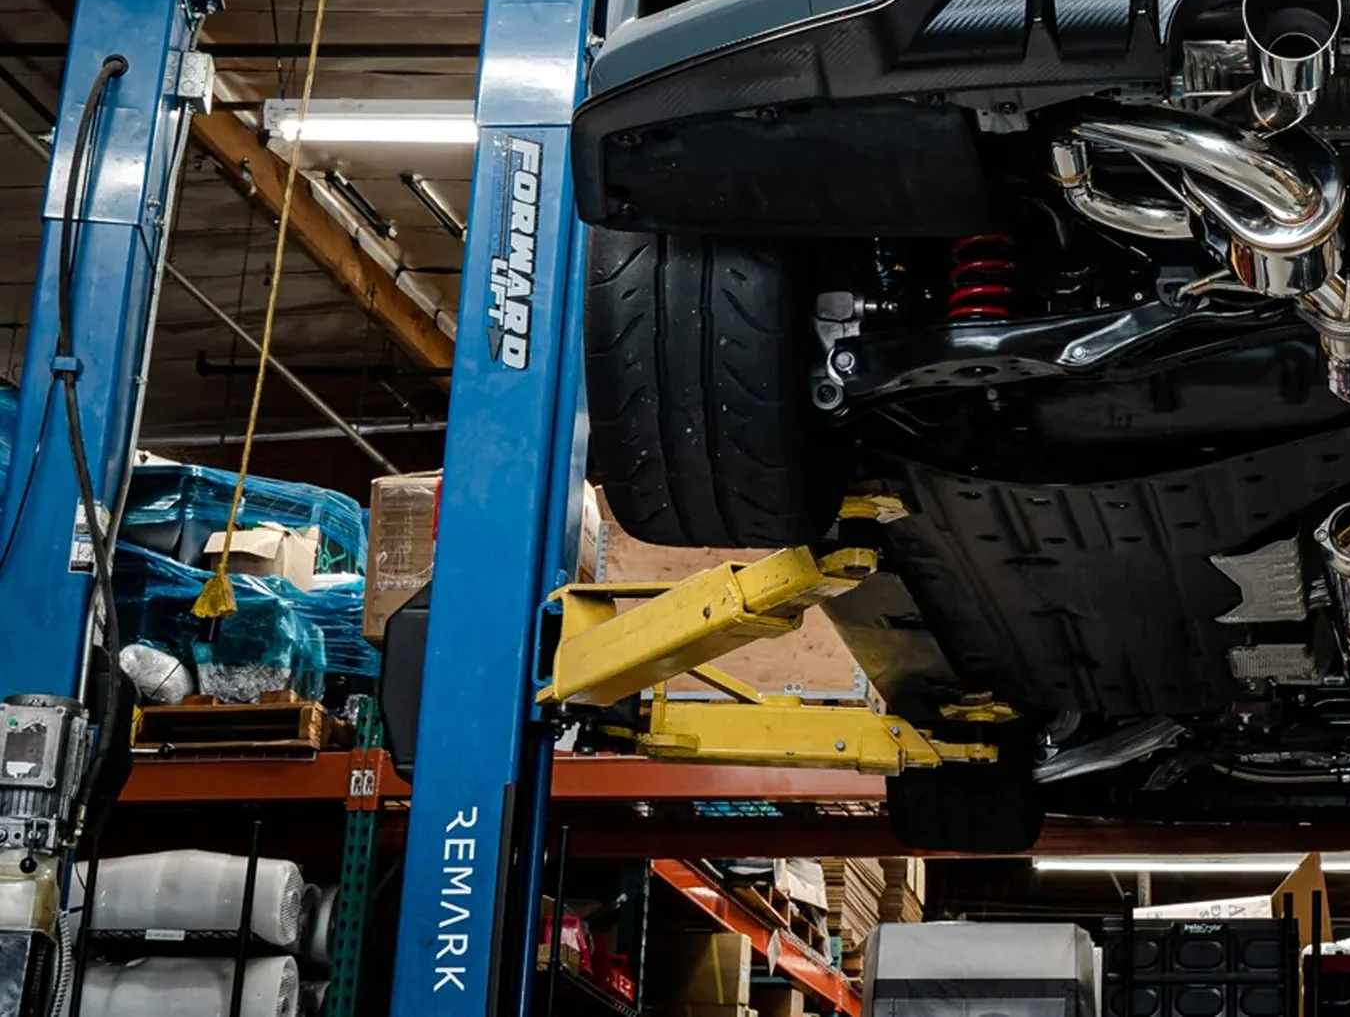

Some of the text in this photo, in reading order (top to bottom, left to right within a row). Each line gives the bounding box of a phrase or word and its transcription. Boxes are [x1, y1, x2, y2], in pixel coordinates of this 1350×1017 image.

[488, 255, 512, 327] LIFT
[501, 135, 544, 371] FORWARD
[433, 806, 479, 992] REMARK
